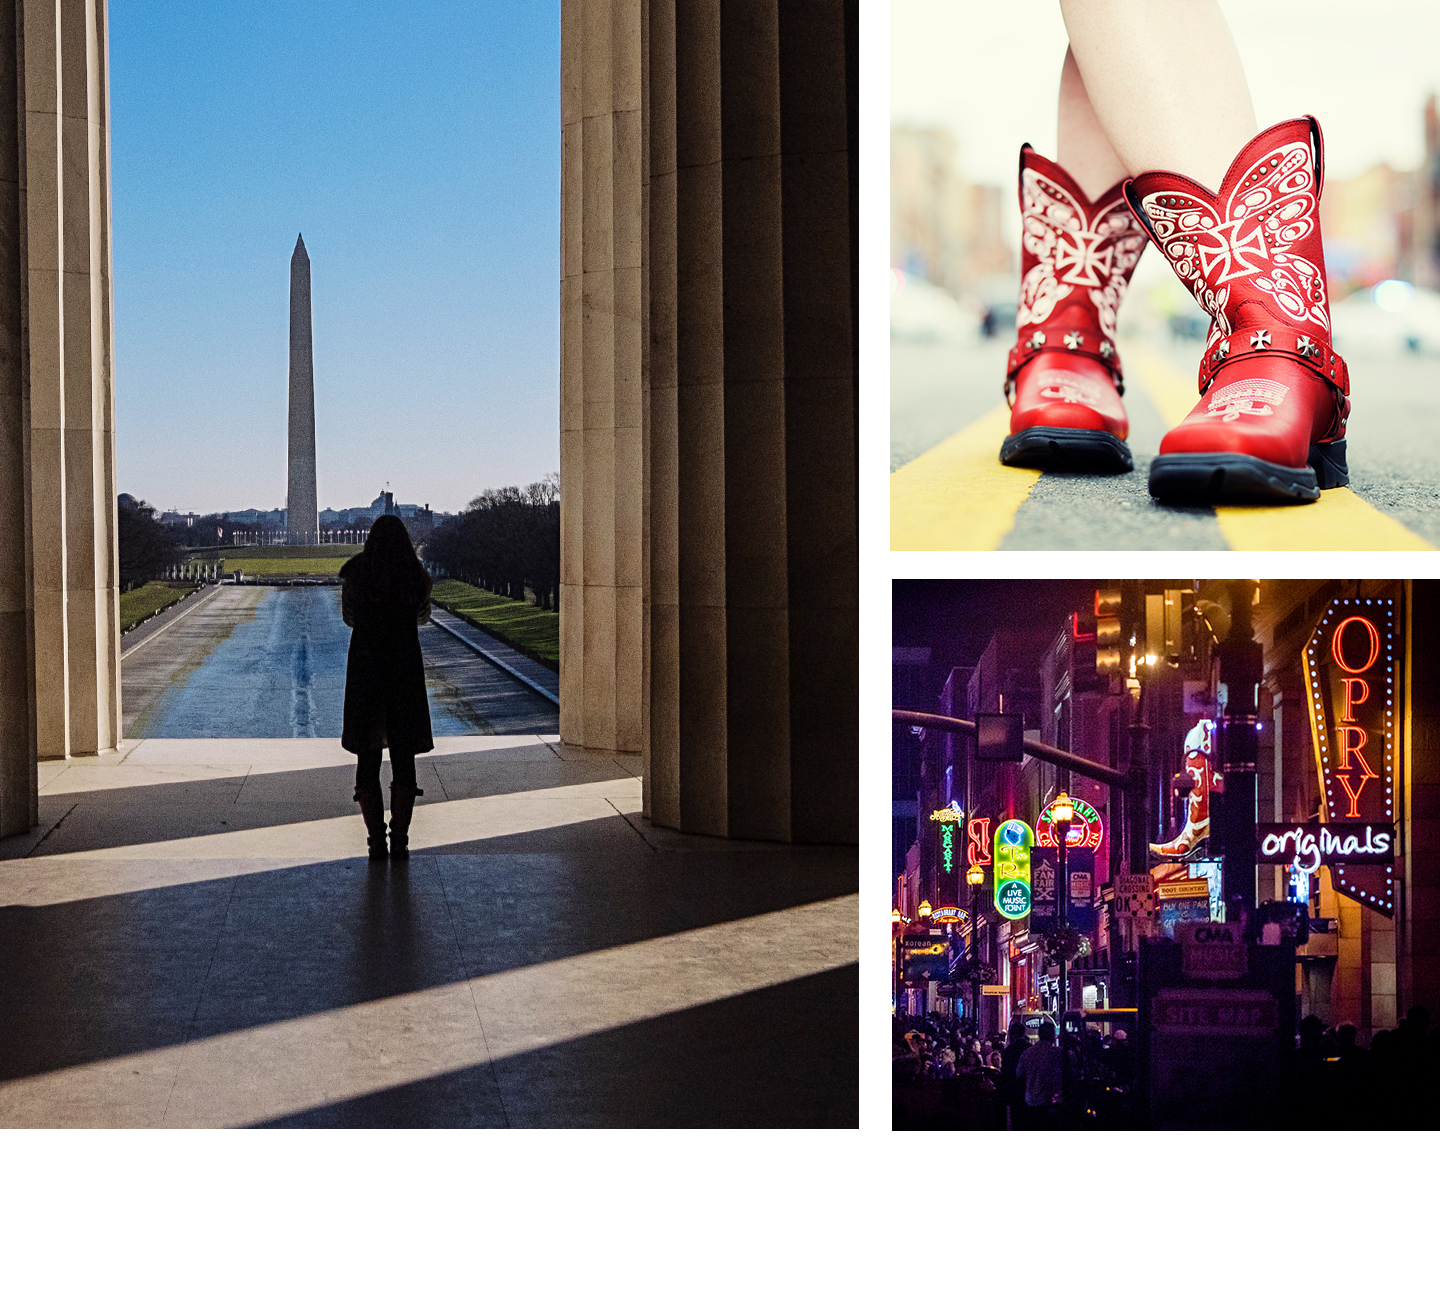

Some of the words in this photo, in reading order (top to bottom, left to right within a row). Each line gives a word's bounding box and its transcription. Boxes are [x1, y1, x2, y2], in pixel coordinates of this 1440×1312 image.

[1331, 615, 1381, 818] OPRY
[1000, 845, 1028, 862] Tin
[1261, 826, 1391, 873] originals
[997, 861, 1031, 882] Roof
[1033, 870, 1055, 879] FAN
[1033, 879, 1055, 888] FAIR
[1119, 876, 1150, 884] DIAGONAL
[1007, 889, 1022, 897] LIVE
[1120, 884, 1150, 893] CROSSING
[1002, 896, 1027, 905] MUSIC
[1116, 896, 1131, 912] OK
[1163, 902, 1177, 911] BUY
[1192, 899, 1208, 909] PAIR
[1004, 904, 1026, 912] JOINT
[1163, 918, 1176, 928] GET
[1194, 926, 1234, 943] CMA
